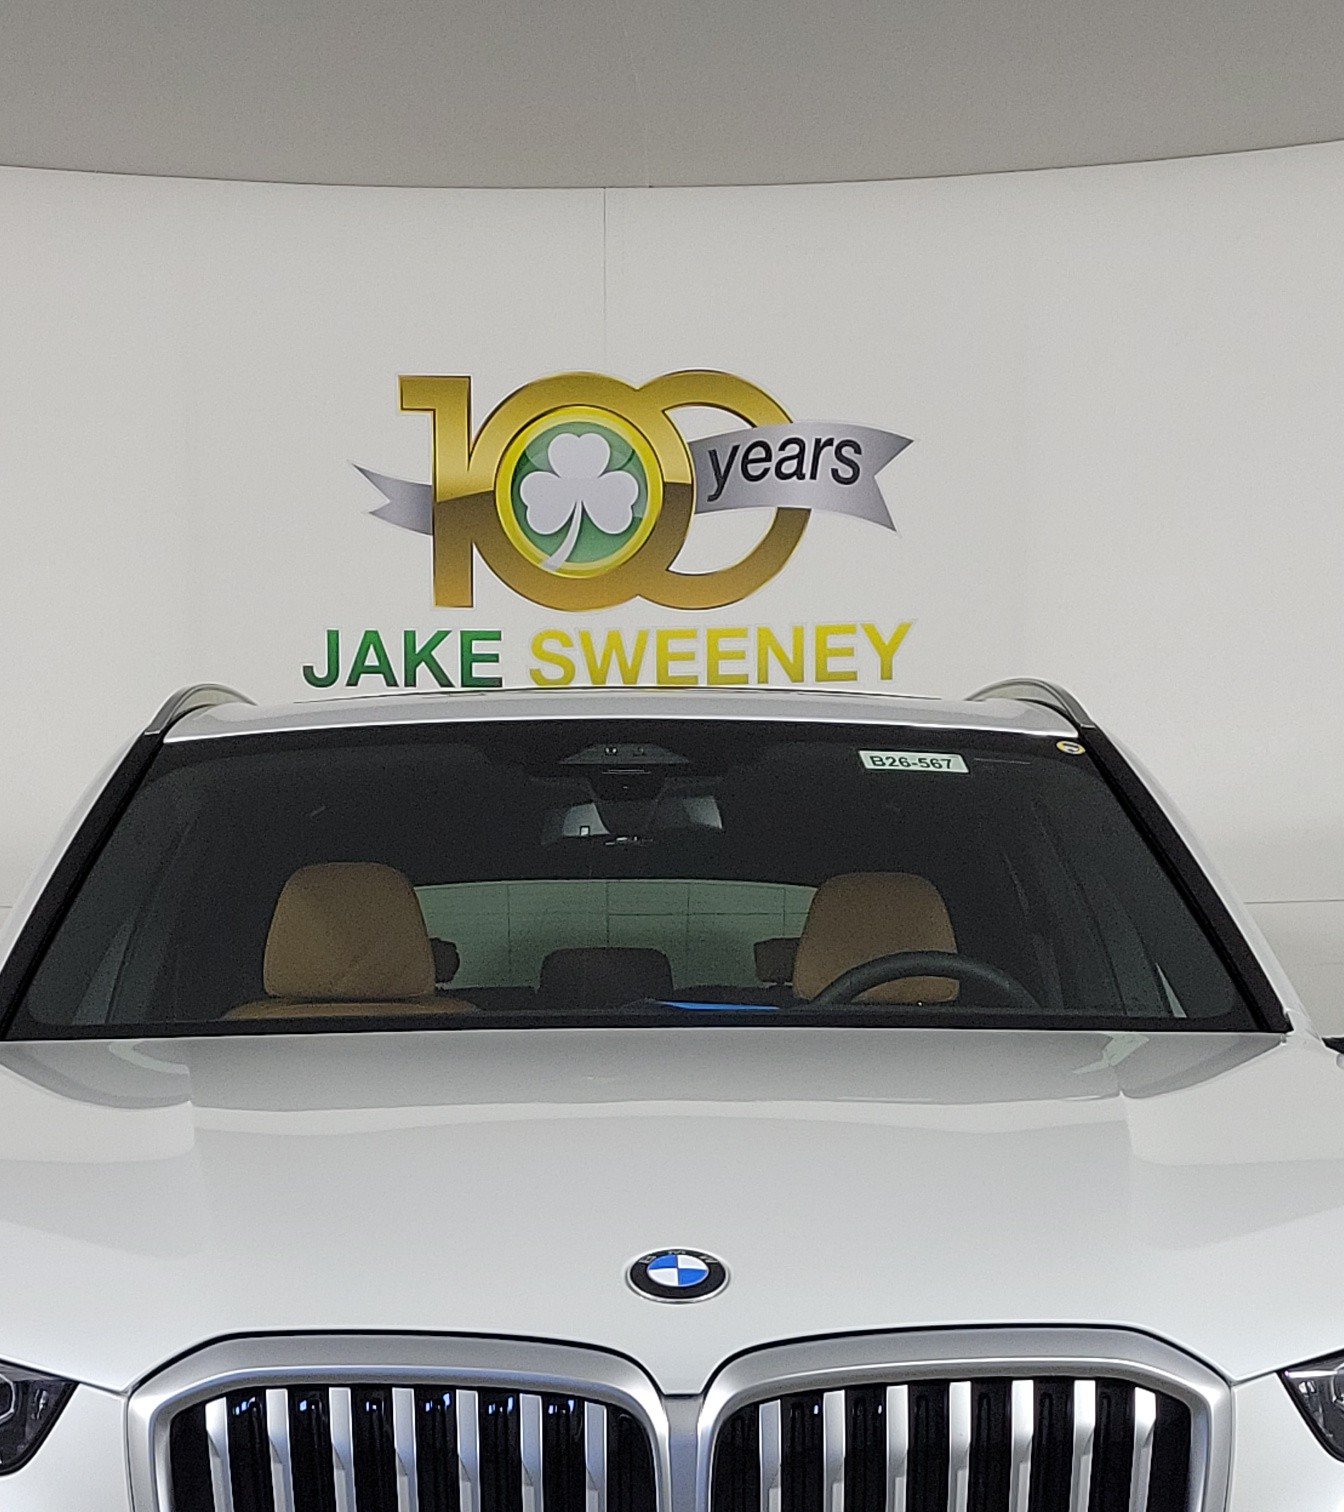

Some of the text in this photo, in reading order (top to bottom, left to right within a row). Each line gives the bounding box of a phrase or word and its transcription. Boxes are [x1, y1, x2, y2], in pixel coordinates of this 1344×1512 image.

[398, 370, 862, 611] 100 years
[303, 622, 913, 688] JAKE SWEENEY
[869, 755, 952, 770] B26-567
